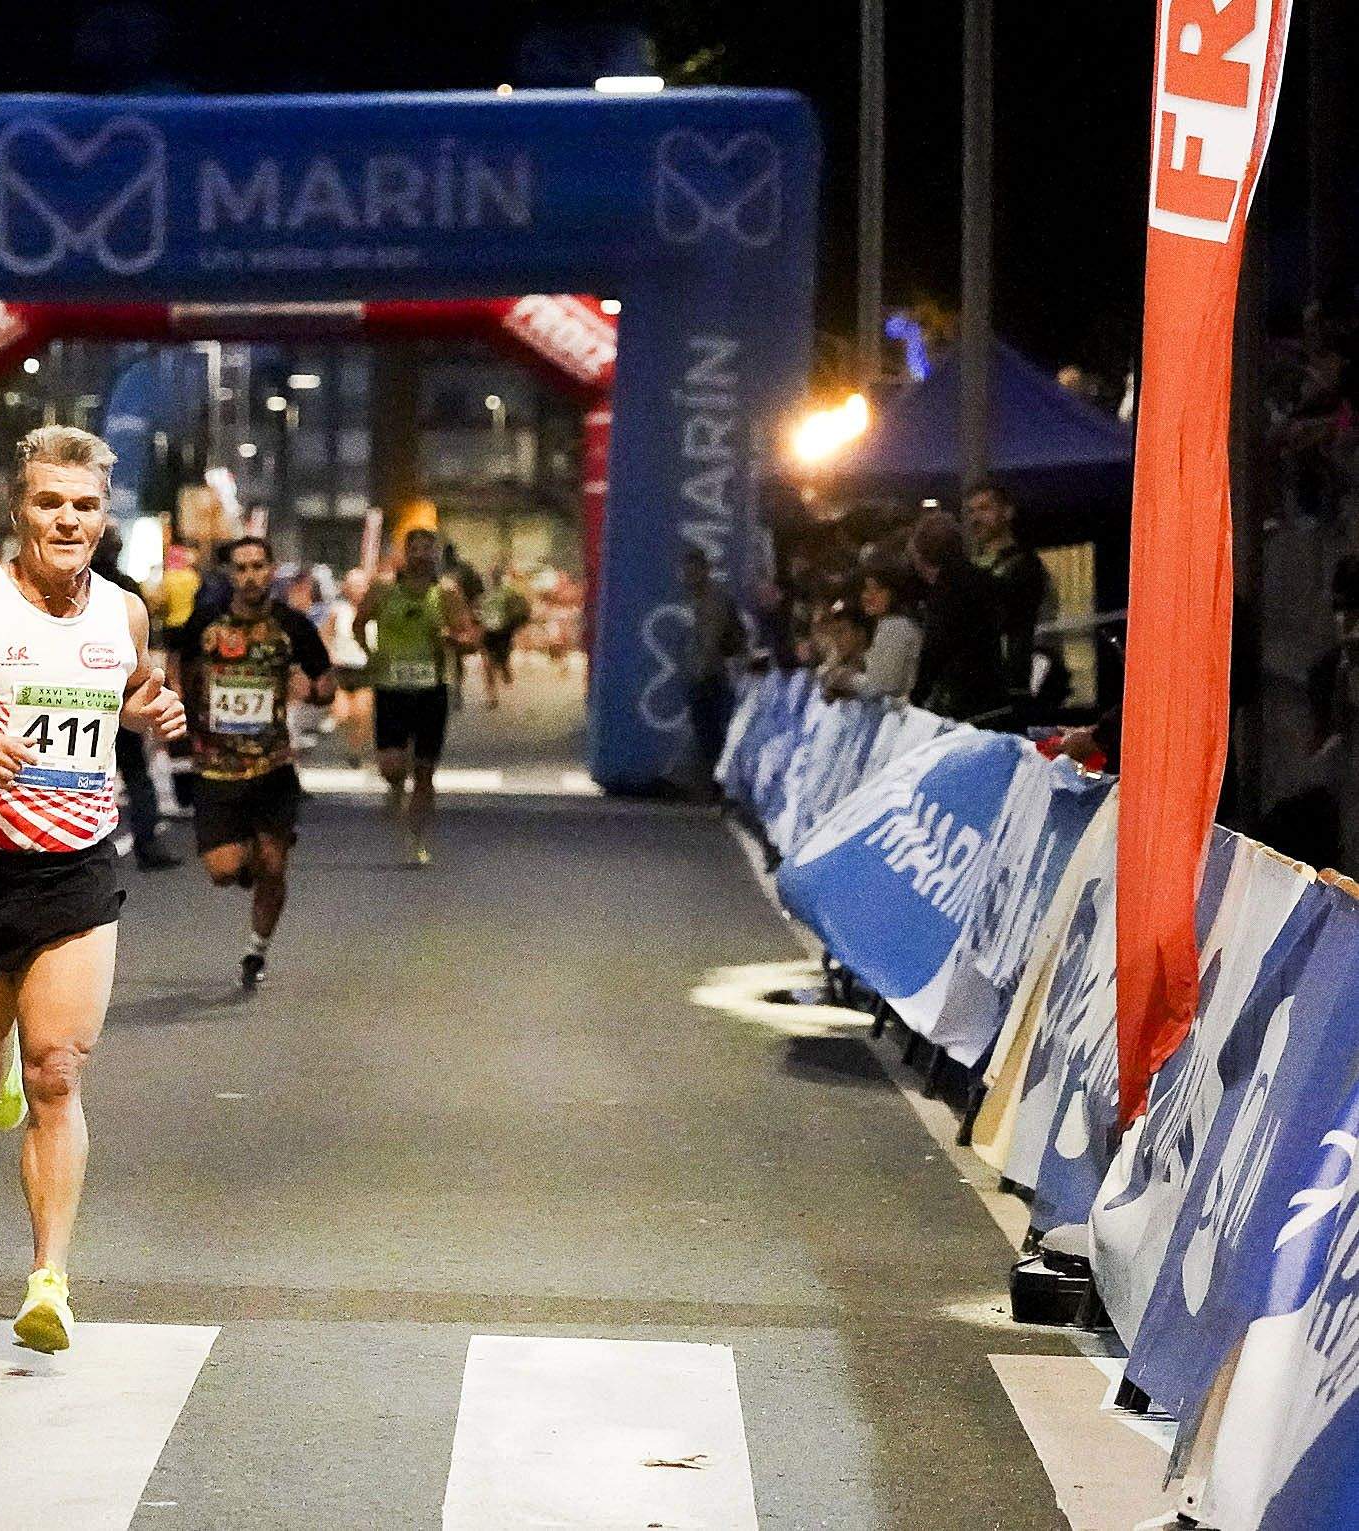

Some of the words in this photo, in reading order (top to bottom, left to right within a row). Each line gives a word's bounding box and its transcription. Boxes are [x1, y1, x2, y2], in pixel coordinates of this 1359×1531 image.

[198, 137, 531, 232] MARÍN
[37, 697, 62, 706] SAN
[215, 693, 265, 716] 457
[22, 714, 101, 758] 411
